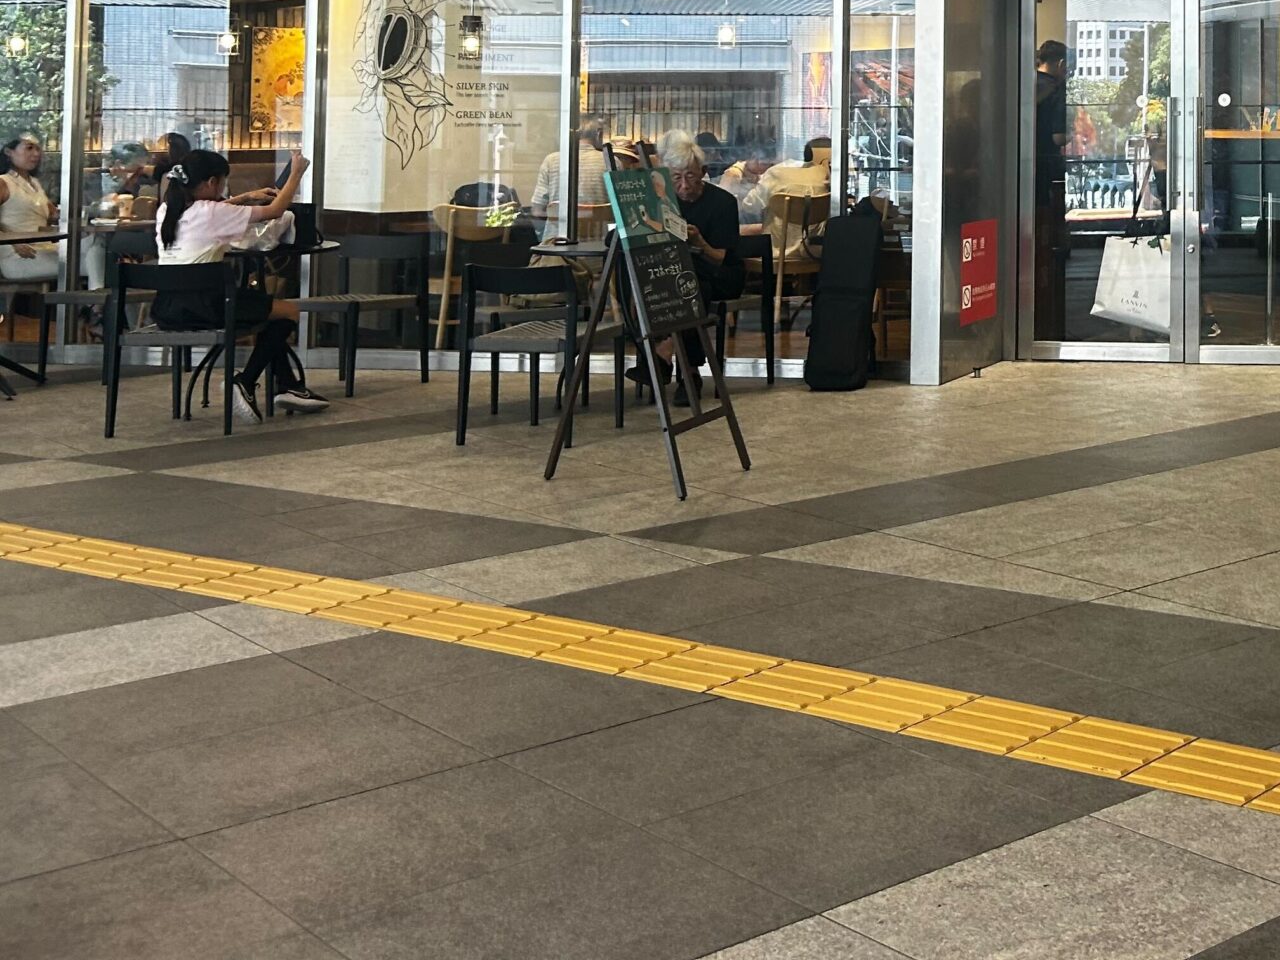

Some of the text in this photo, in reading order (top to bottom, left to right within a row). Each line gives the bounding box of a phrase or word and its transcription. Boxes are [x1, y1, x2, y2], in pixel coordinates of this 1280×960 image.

[456, 82, 510, 91] SILVER SKIN
[455, 110, 513, 119] GREEN BEAN
